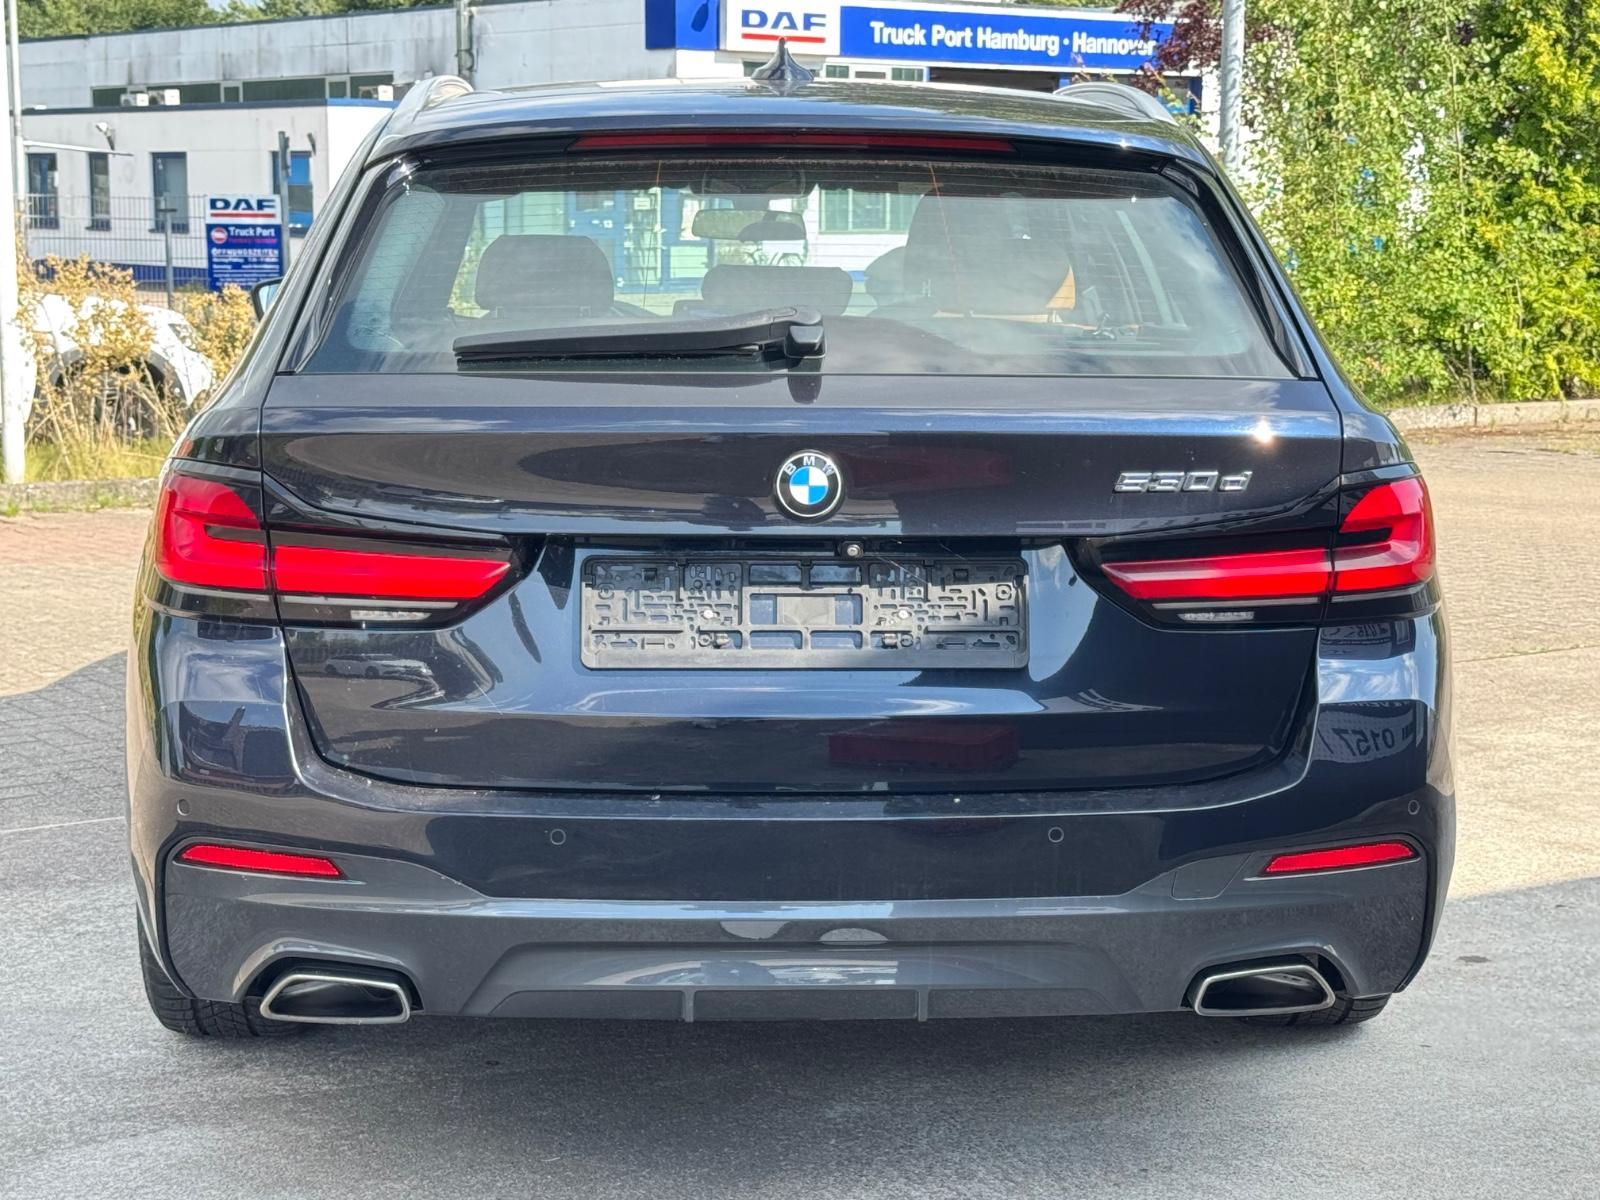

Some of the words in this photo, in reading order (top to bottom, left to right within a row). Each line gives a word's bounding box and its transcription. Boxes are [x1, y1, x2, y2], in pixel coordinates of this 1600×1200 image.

[742, 10, 827, 31] DAF
[870, 21, 926, 46] Truck
[931, 25, 972, 48] Port
[977, 27, 1059, 57] Hamburg
[210, 198, 276, 211] DAF
[228, 227, 254, 236] Truck
[256, 228, 275, 236] Port
[784, 456, 835, 476] BMW
